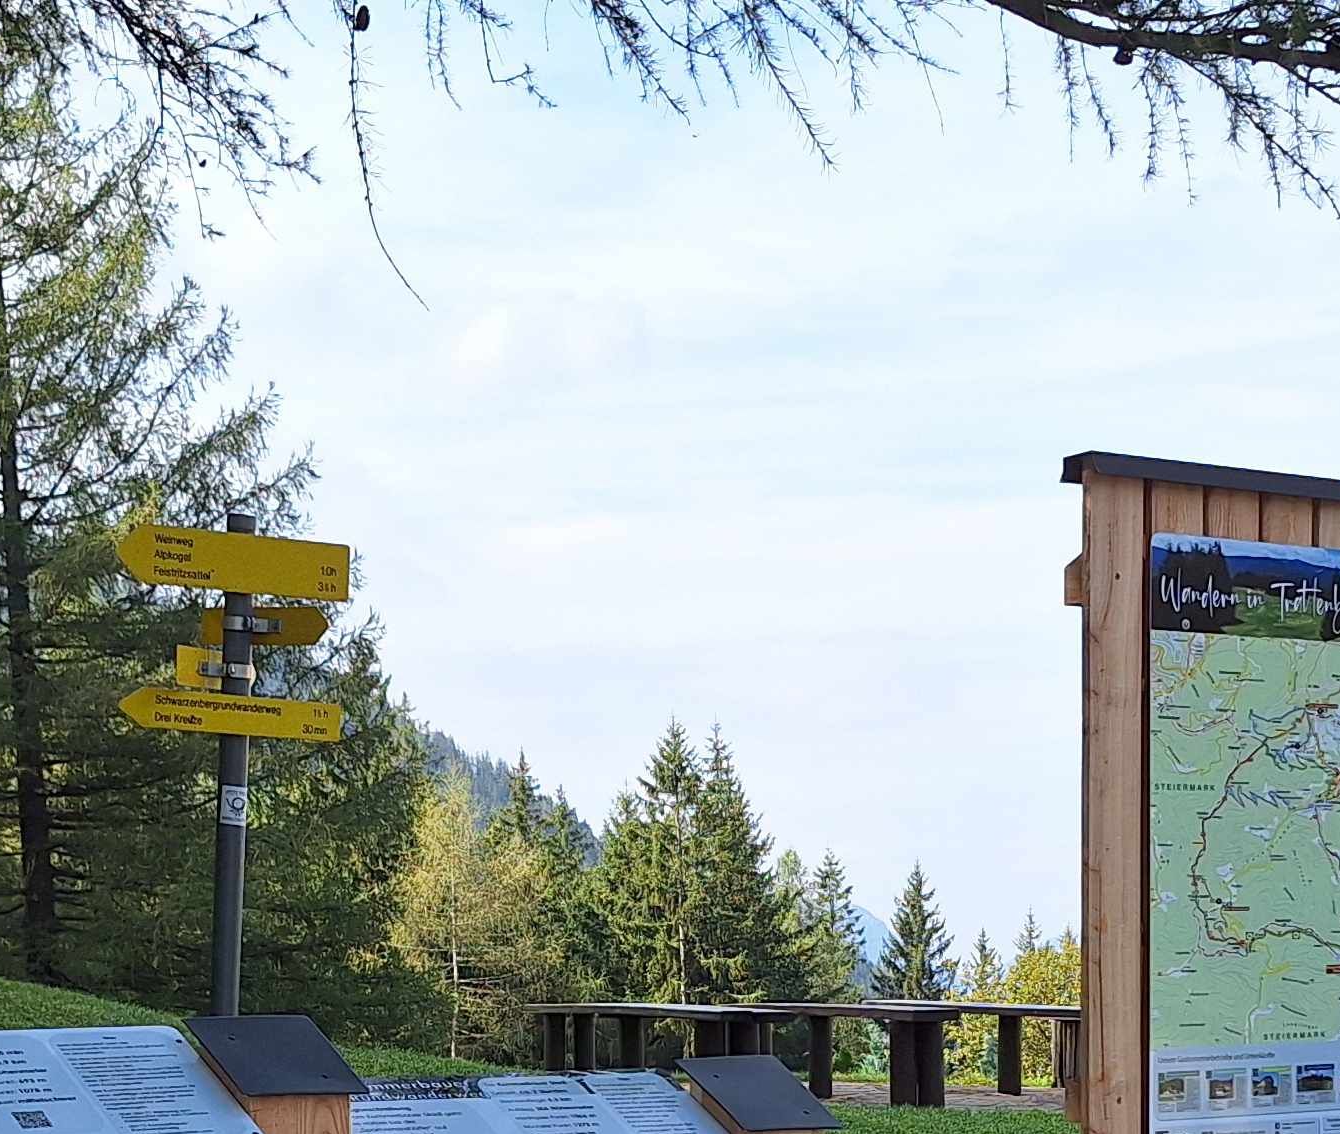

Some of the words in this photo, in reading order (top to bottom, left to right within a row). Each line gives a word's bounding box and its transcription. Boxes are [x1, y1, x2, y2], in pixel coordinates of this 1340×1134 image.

[1160, 568, 1243, 617] Wandern
[1246, 588, 1265, 609] in
[154, 711, 172, 722] Drei
[1154, 782, 1216, 792] STEIERMARK
[1262, 1030, 1327, 1042] STEIERMARK
